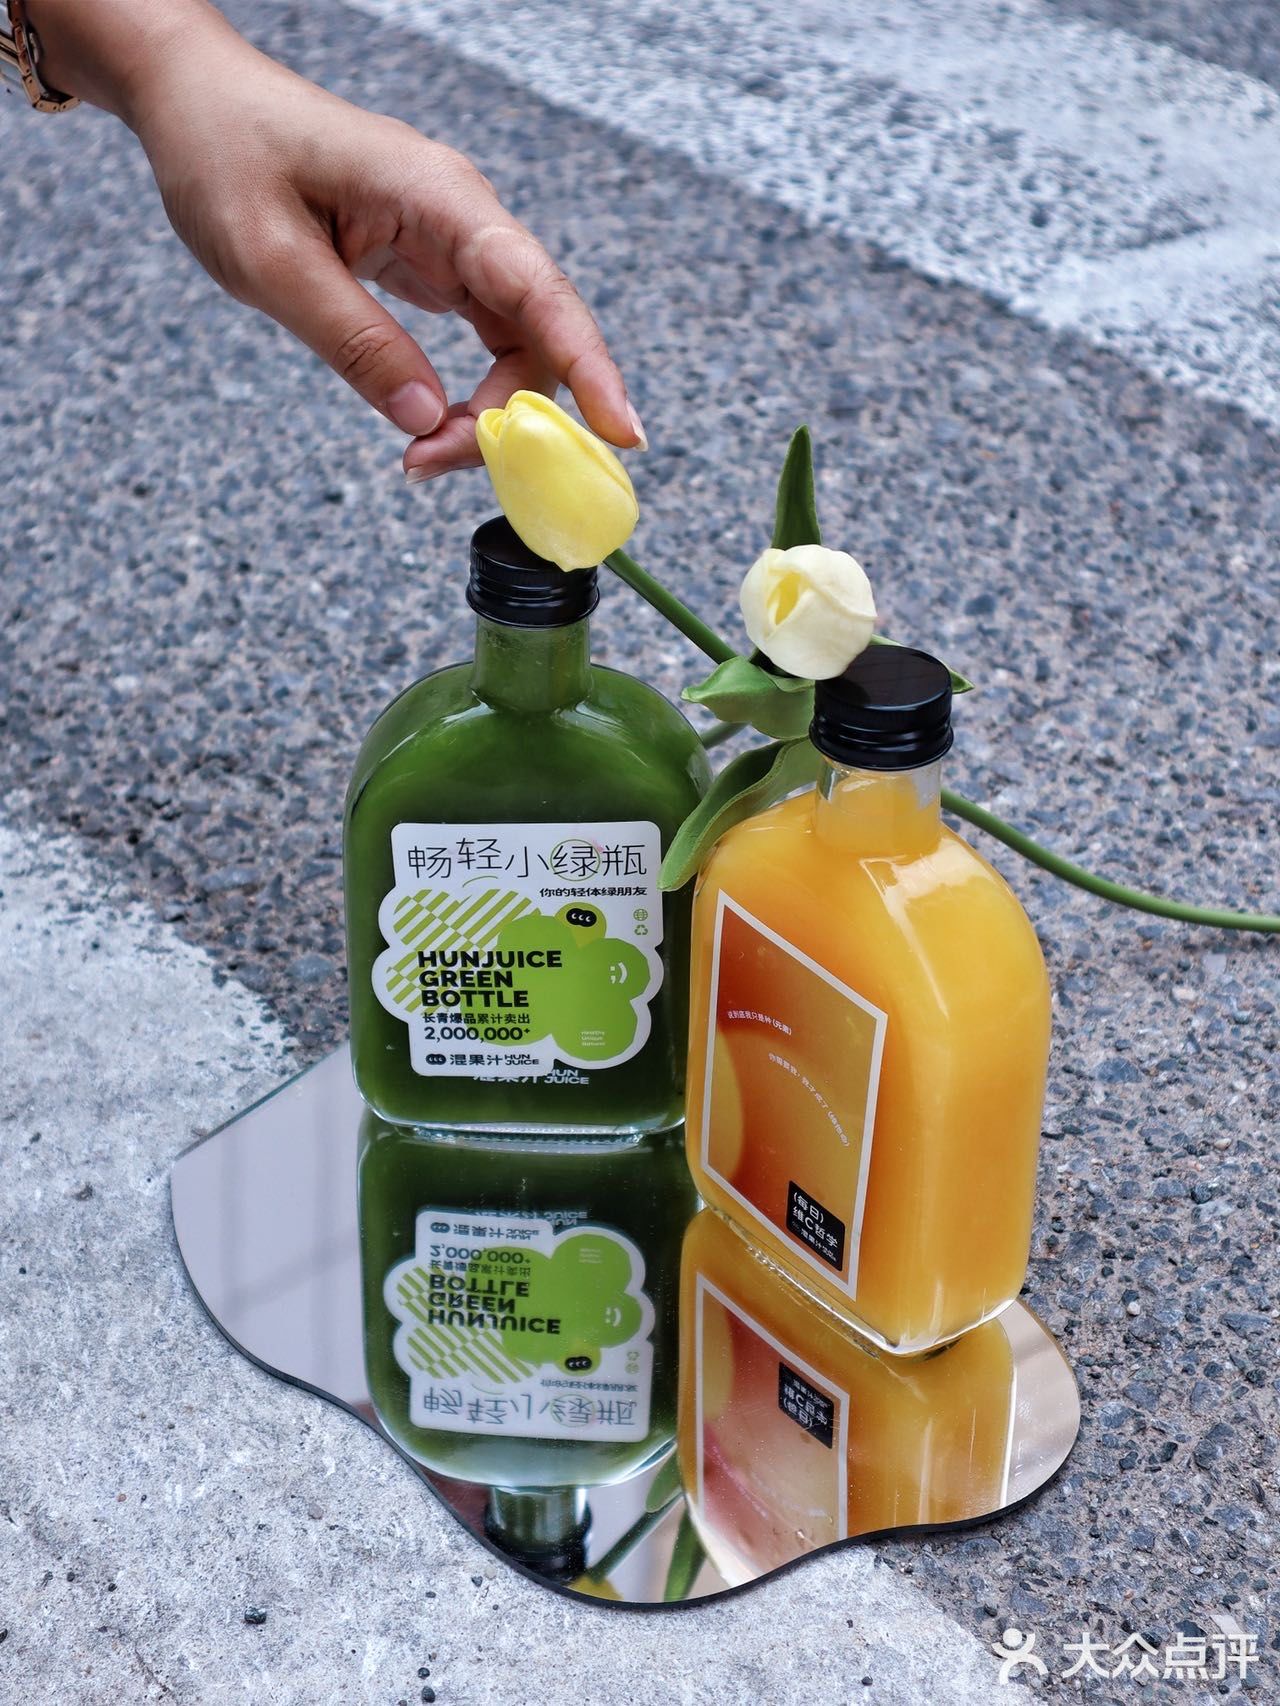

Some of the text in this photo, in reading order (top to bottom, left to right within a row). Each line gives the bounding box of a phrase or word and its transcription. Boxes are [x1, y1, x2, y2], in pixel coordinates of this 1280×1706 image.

[407, 837, 647, 879] 畅轻小绿瓶
[539, 886, 647, 898] 你的轻体绿朋友
[417, 950, 562, 968] HUNJUICE
[419, 970, 513, 988] GREEN
[421, 990, 529, 1007] BOTTLE
[422, 1012, 530, 1024] 长青爆品累计卖出
[450, 1053, 503, 1066] 混果汁
[544, 1076, 590, 1085] JUICE
